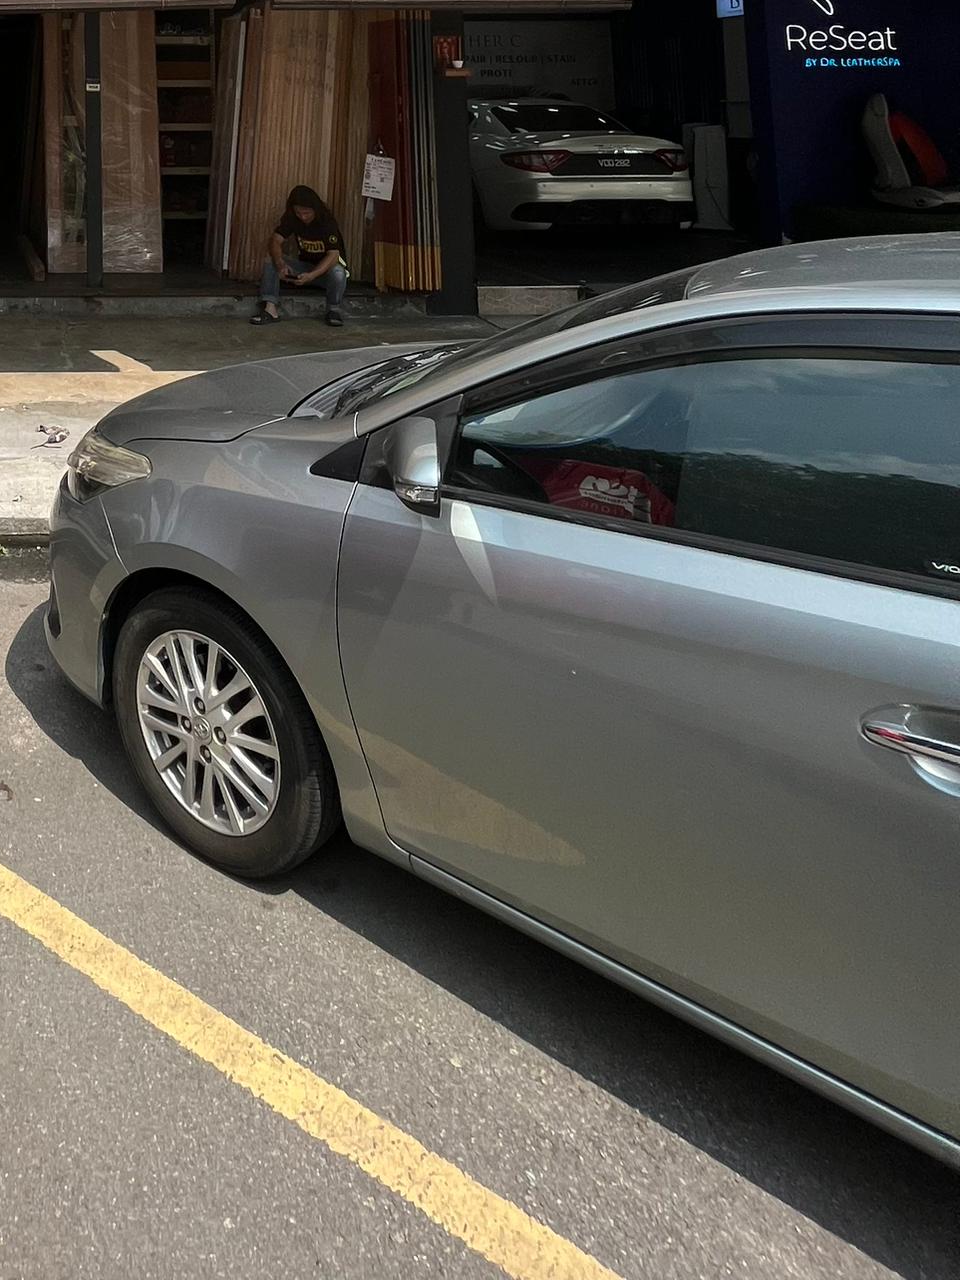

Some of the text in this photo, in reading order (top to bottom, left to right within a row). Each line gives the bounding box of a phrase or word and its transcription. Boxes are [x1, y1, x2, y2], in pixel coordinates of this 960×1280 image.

[786, 24, 898, 51] ReSeat
[805, 57, 818, 67] BY
[931, 561, 960, 574] VIO
